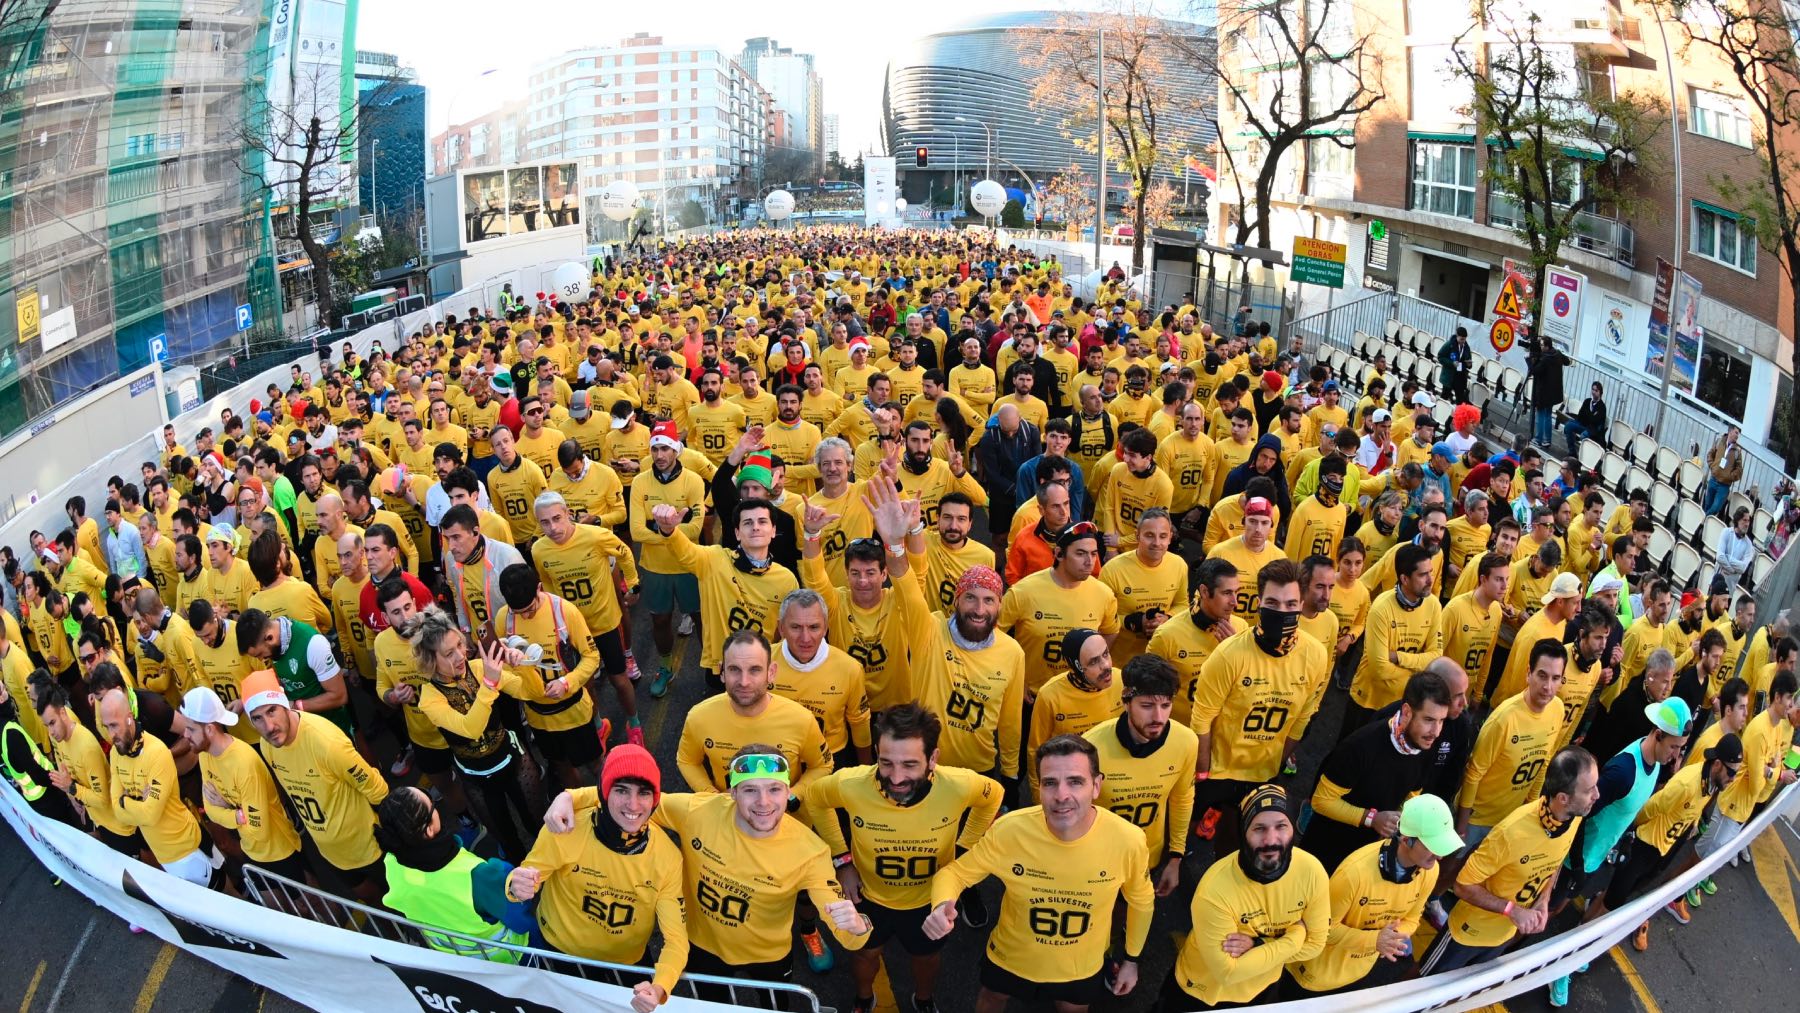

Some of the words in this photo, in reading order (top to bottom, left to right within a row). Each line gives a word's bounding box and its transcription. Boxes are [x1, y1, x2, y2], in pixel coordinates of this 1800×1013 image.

[277, 0, 289, 24] Co
[1307, 258, 1327, 267] Concha
[1327, 261, 1343, 270] Espina
[1308, 250, 1333, 260] OBRAS
[1307, 267, 1327, 275] General
[1496, 329, 1510, 342] 30
[1196, 387, 1211, 398] 60
[703, 434, 725, 450] 60
[1180, 470, 1202, 485] 60
[505, 499, 528, 517] 60
[1311, 538, 1332, 556] 60
[560, 578, 594, 602] 60
[470, 600, 489, 622] 6
[1043, 640, 1062, 664] 6
[1465, 649, 1487, 671] 60
[1717, 665, 1733, 682] 60
[213, 683, 239, 704] 60
[1243, 706, 1289, 733] 60
[1511, 758, 1546, 785] 60
[1111, 796, 1125, 804] SAN
[1127, 792, 1163, 800] SILVESTRE
[290, 793, 326, 824] 60
[1108, 801, 1160, 829] 60
[893, 845, 939, 854] SILVESTRE
[875, 856, 937, 880] 60
[1026, 872, 1055, 881] nederlanden
[712, 878, 754, 901] SILVESTRE
[883, 880, 927, 888] VALLECANA
[1031, 886, 1093, 897] NATIONALE-NEDERLANDEN
[584, 889, 598, 897] SAN
[600, 891, 638, 904] SILVESTRE
[697, 880, 751, 925] 60
[1029, 897, 1045, 905] SAN
[1047, 897, 1093, 910] SILVESTRE
[582, 895, 635, 928] 60
[699, 907, 739, 929] VALLECANA
[587, 914, 624, 936] VALLECANA
[1029, 906, 1091, 939] 60
[1035, 937, 1079, 946] VALLECANA
